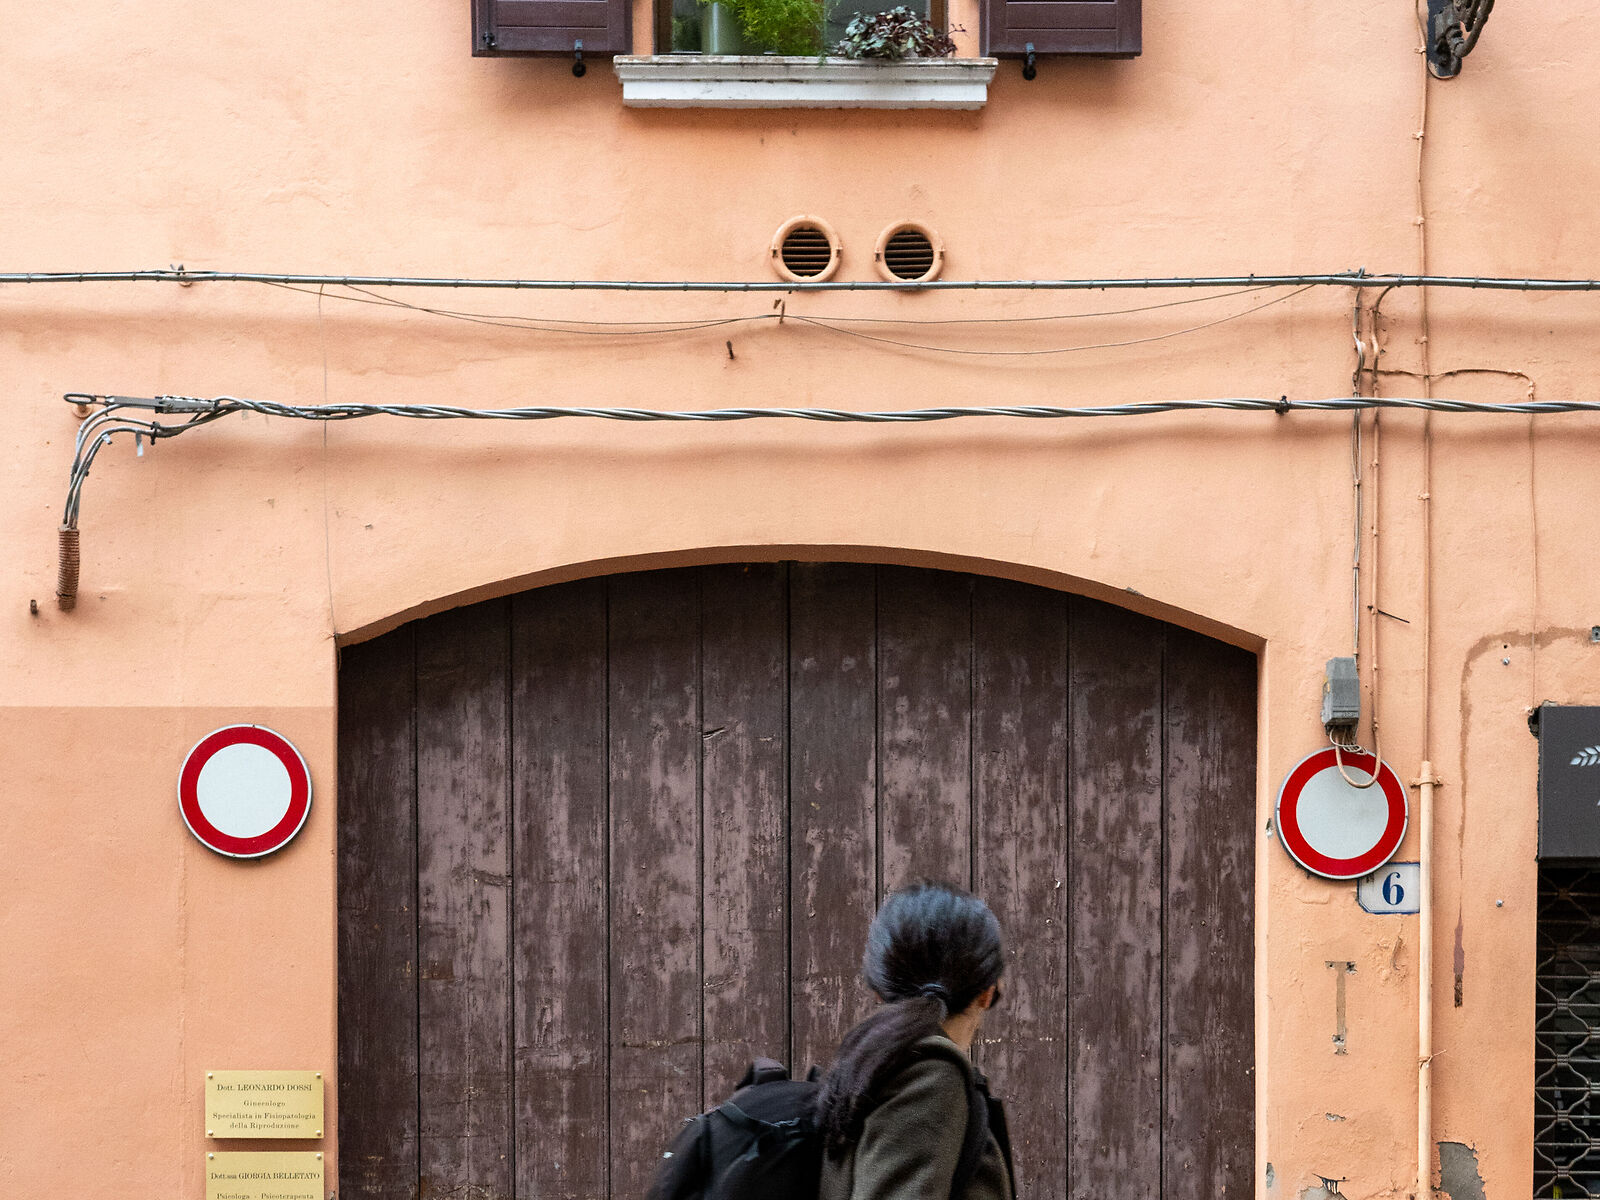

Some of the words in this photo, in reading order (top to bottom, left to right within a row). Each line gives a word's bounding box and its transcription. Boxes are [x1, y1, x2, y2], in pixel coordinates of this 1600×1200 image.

[1382, 871, 1405, 906] 6
[264, 1112, 316, 1120] Fisiopatologia
[250, 1122, 299, 1130] Riproduzione
[238, 1172, 271, 1180] GIORGIA
[273, 1172, 320, 1180] BELLETATO
